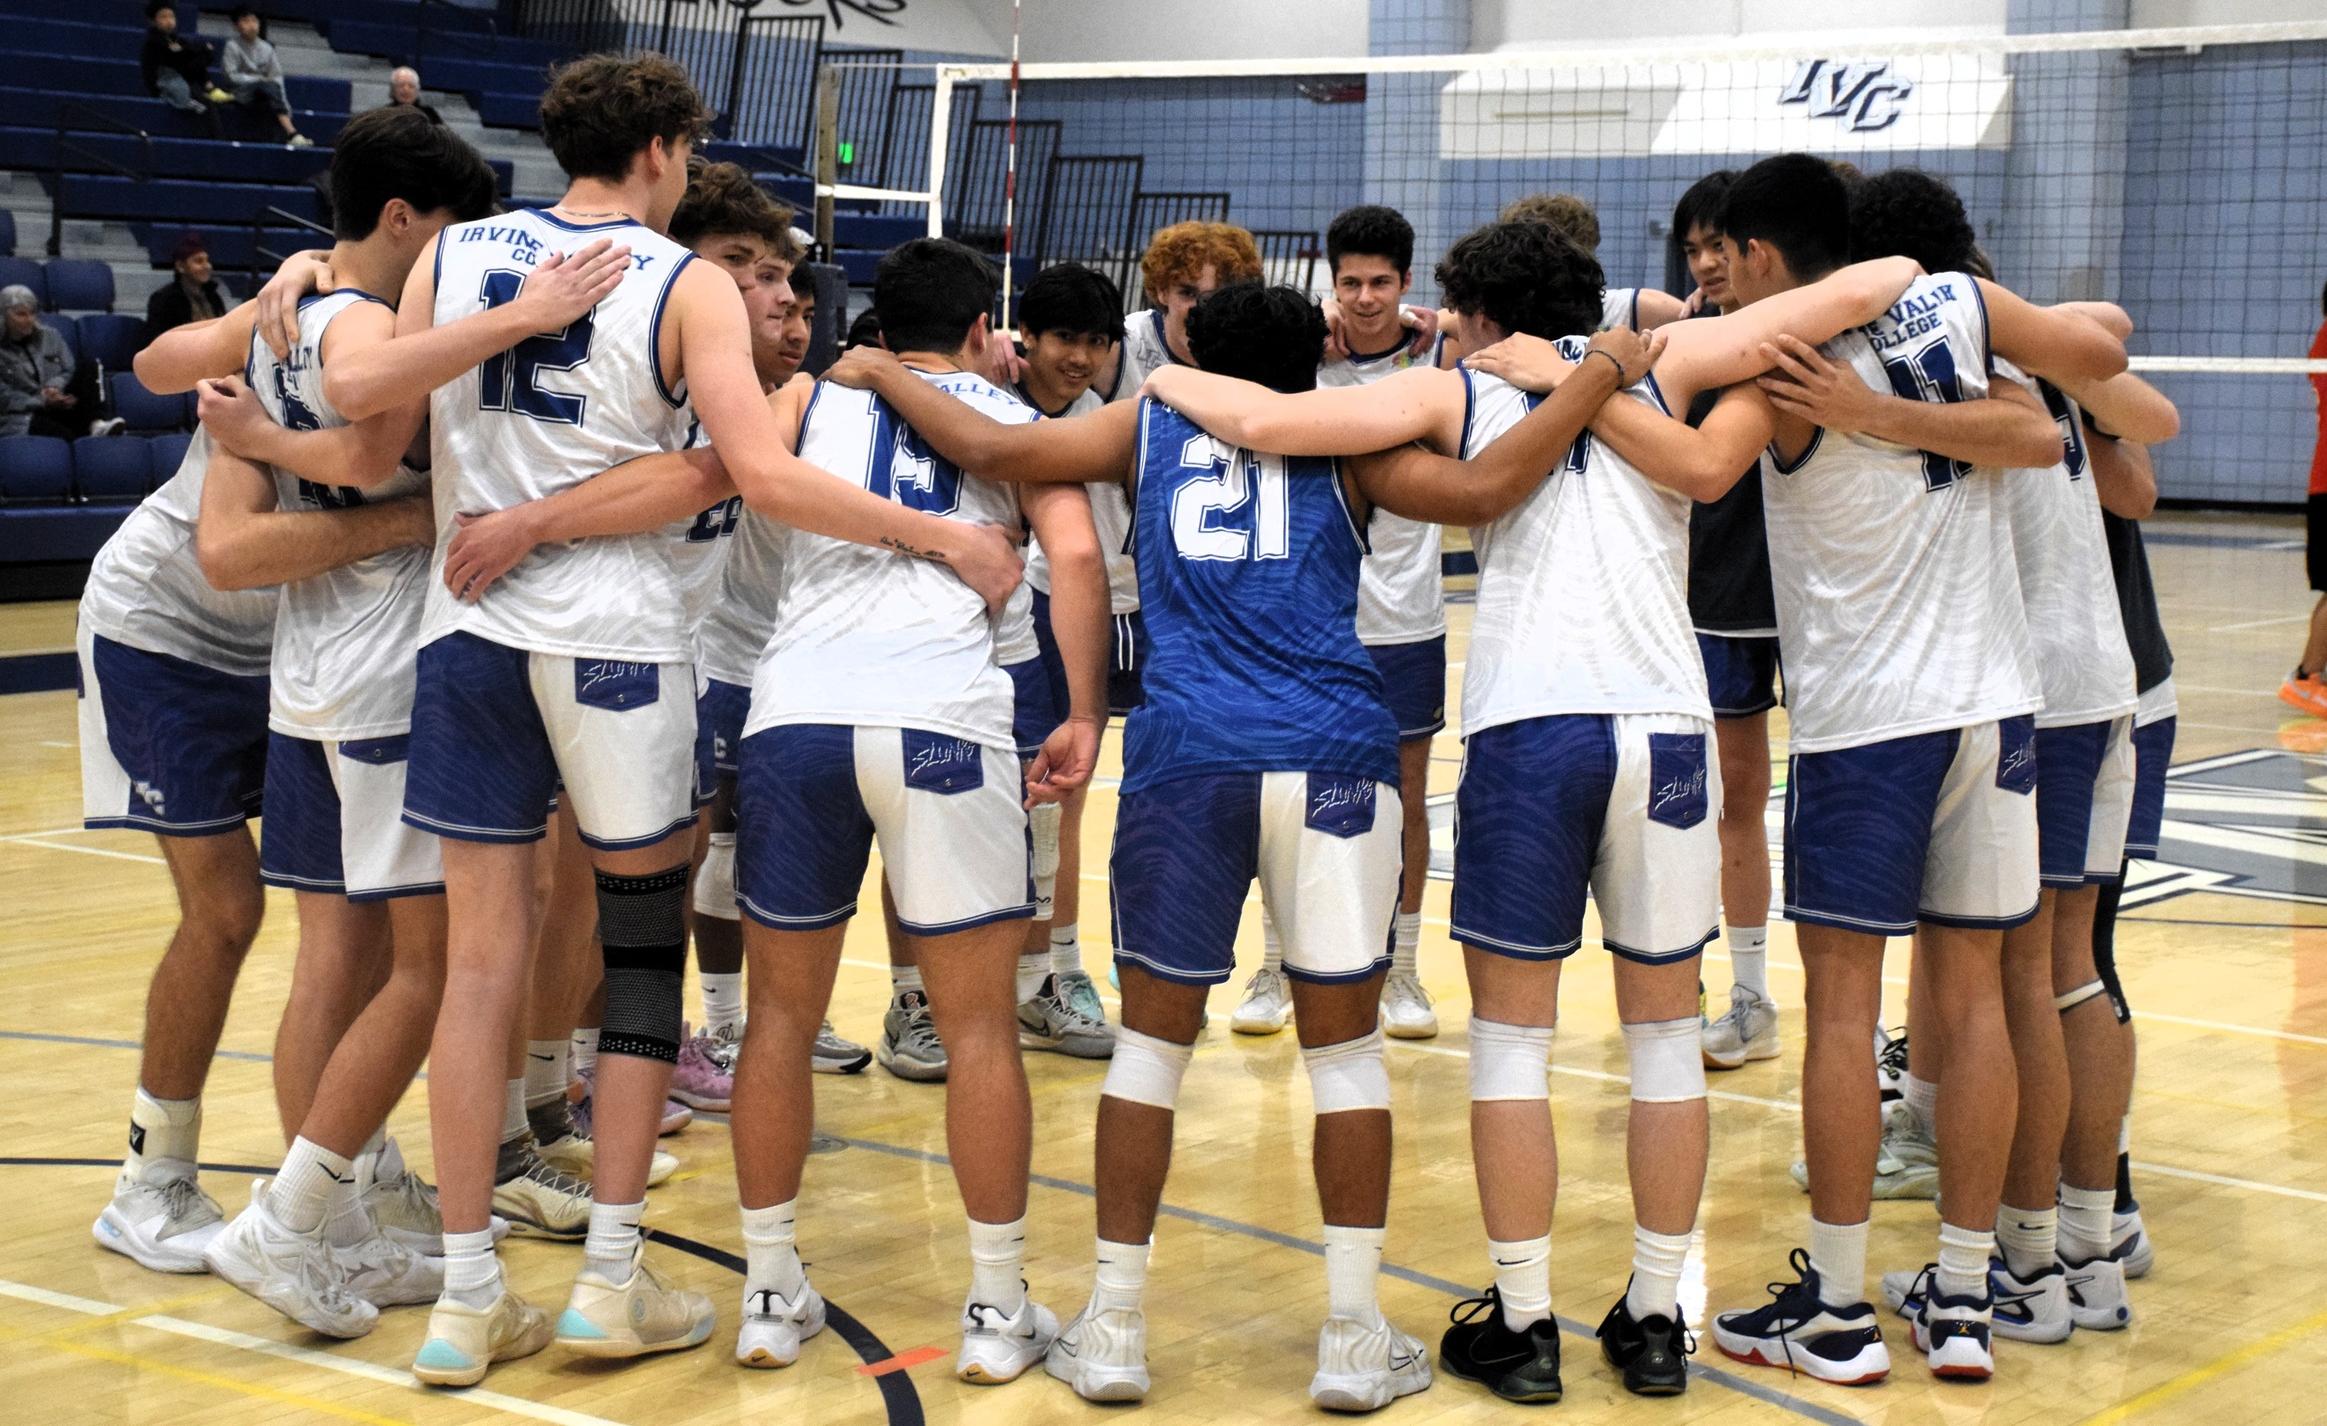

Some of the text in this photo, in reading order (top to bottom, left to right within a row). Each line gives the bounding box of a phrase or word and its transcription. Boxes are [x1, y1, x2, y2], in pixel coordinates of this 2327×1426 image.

[1777, 57, 1914, 133] IVC
[459, 226, 544, 252] IRVINE
[478, 268, 597, 428] 12
[1868, 312, 1943, 354] OLLEGE
[940, 382, 1021, 405] ALLEY
[1170, 432, 1290, 562] 21
